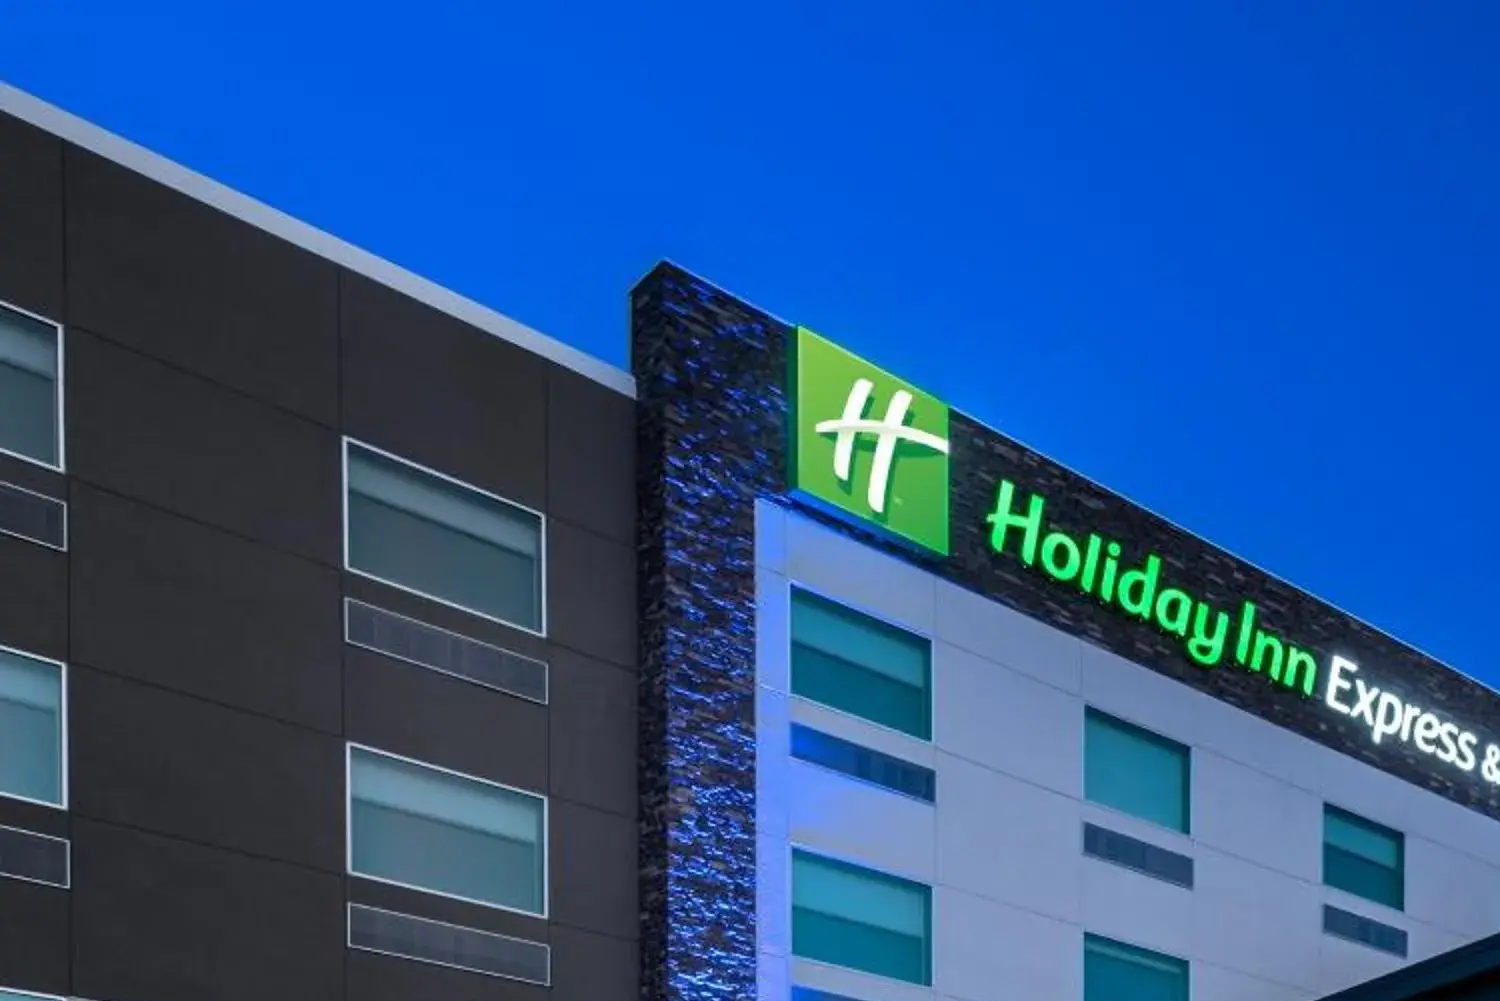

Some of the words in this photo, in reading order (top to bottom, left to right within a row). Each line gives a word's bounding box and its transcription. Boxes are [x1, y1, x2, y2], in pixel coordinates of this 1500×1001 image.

[815, 378, 950, 513] H
[986, 479, 1230, 665] Holiday
[1235, 600, 1318, 696] Inn
[1326, 655, 1478, 771] Express
